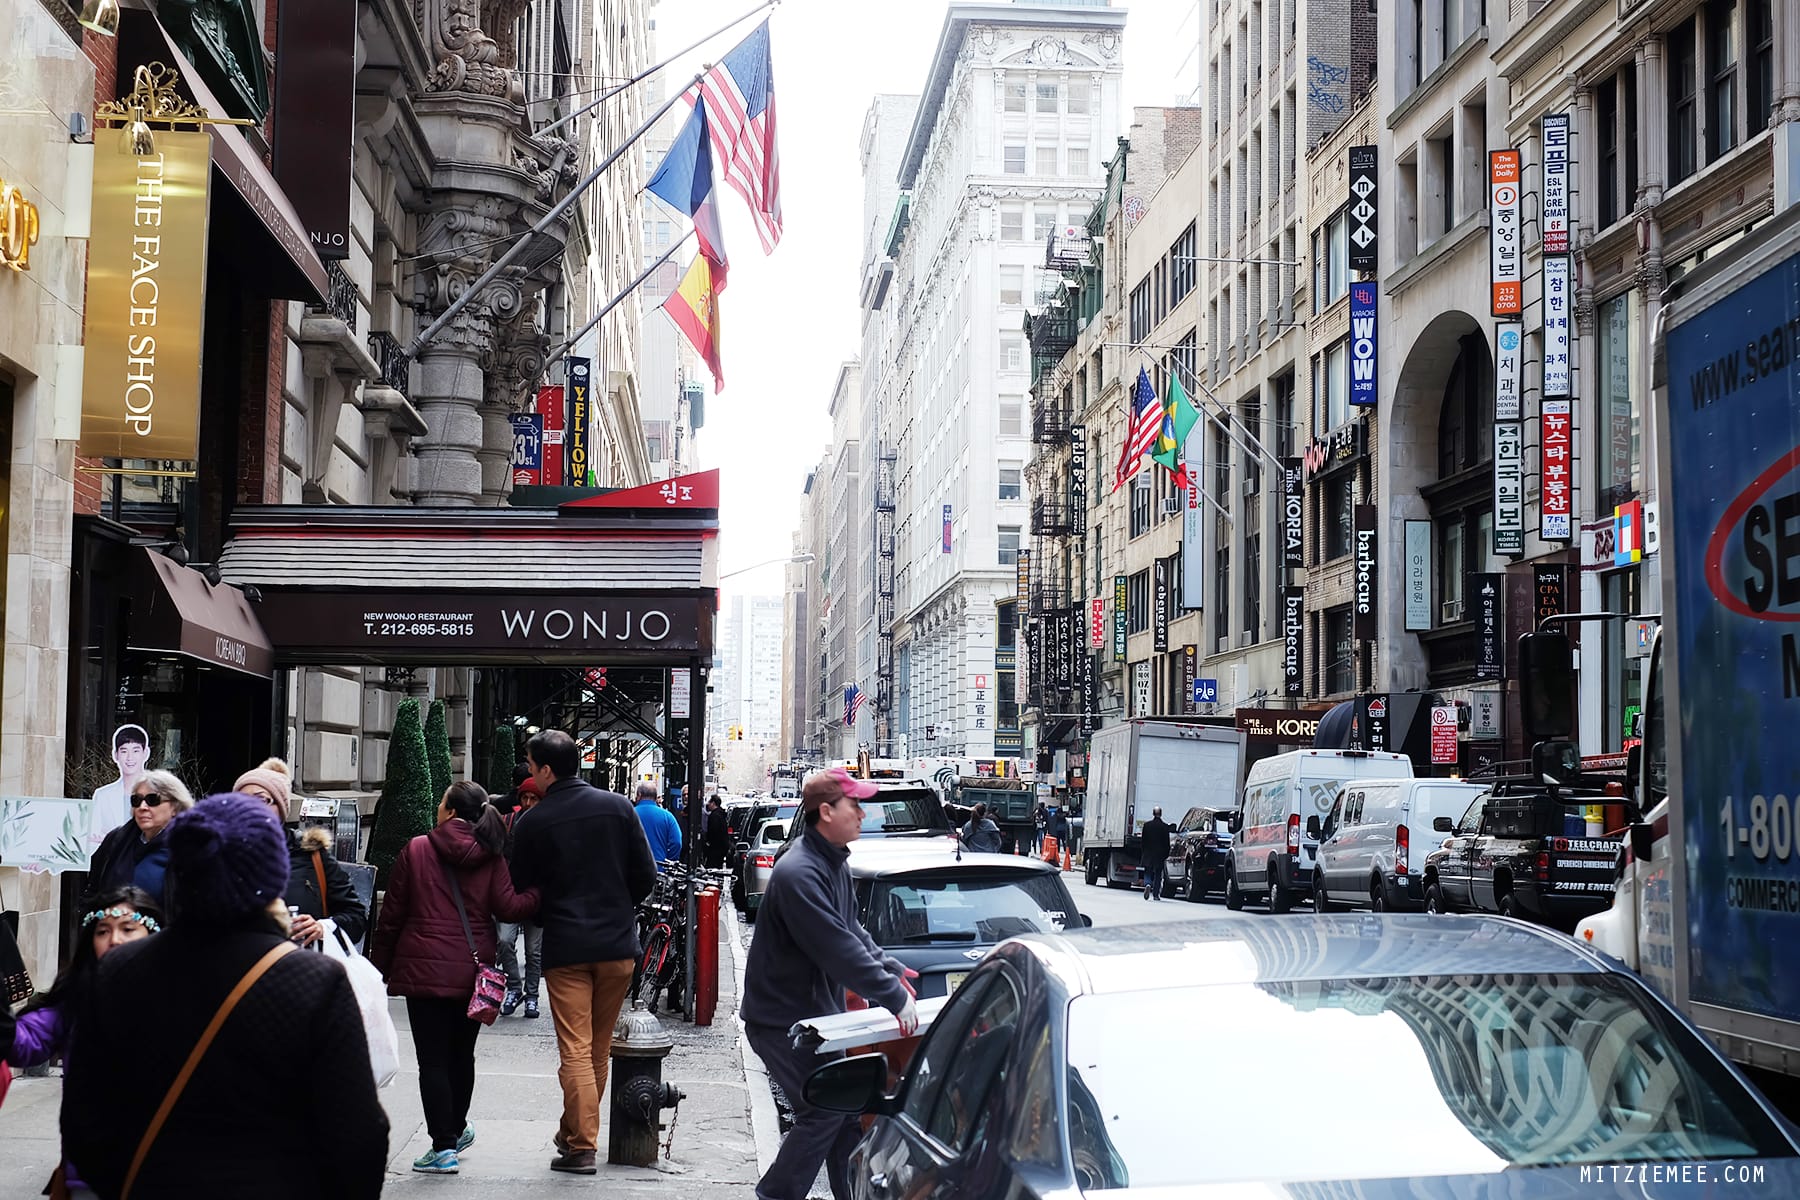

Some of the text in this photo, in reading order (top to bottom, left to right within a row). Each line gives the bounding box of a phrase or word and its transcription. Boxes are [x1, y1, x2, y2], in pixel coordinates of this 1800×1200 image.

[1545, 130, 1567, 174] 토플
[1547, 177, 1562, 186] ESL
[1547, 188, 1562, 197] SAT
[1544, 208, 1567, 218] GMAT
[1546, 199, 1563, 207] GRE
[1551, 220, 1561, 229] 6F
[1497, 209, 1516, 277] 중앙일보
[125, 153, 164, 436] THE FACE SHOP
[1353, 317, 1374, 380] WOW
[659, 480, 693, 504] 원조
[1286, 469, 1296, 494] miss
[1286, 495, 1301, 550] KOREA
[1547, 516, 1566, 524] 7FL
[1357, 529, 1375, 614] barbecue
[1540, 585, 1559, 594] CPA
[1543, 597, 1556, 605] EA
[418, 613, 474, 621] RESTAURANT
[1158, 585, 1167, 640] ebenezer
[364, 623, 474, 635] T. 212-695-5815
[501, 609, 671, 641] WONJO
[1286, 596, 1303, 676] barbecue
[215, 636, 235, 661] KOREAN
[1290, 683, 1300, 691] 2F
[975, 690, 986, 729] 正官庄
[1250, 724, 1273, 735] miss
[1555, 881, 1586, 890] 24HR
[1727, 877, 1800, 913] COMMERC
